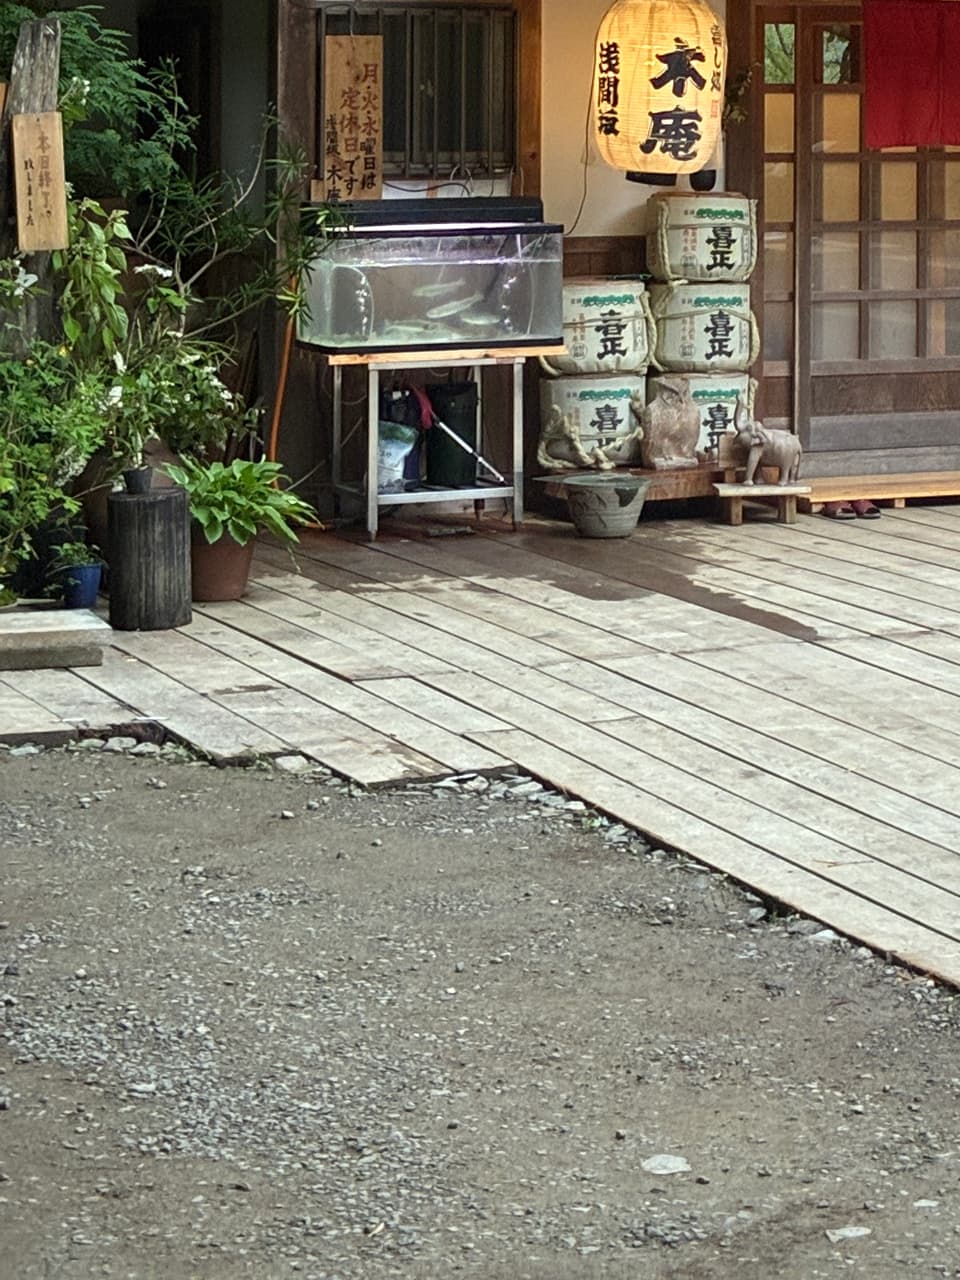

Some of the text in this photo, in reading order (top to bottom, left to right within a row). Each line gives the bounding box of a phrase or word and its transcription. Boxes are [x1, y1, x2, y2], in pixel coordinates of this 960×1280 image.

[361, 63, 379, 191] 月・火・水曜日は
[640, 37, 706, 160] 木庵
[340, 86, 361, 196] 定休日です
[705, 226, 737, 271] 喜正
[594, 309, 627, 360] 喜正
[704, 309, 734, 360] 喜正
